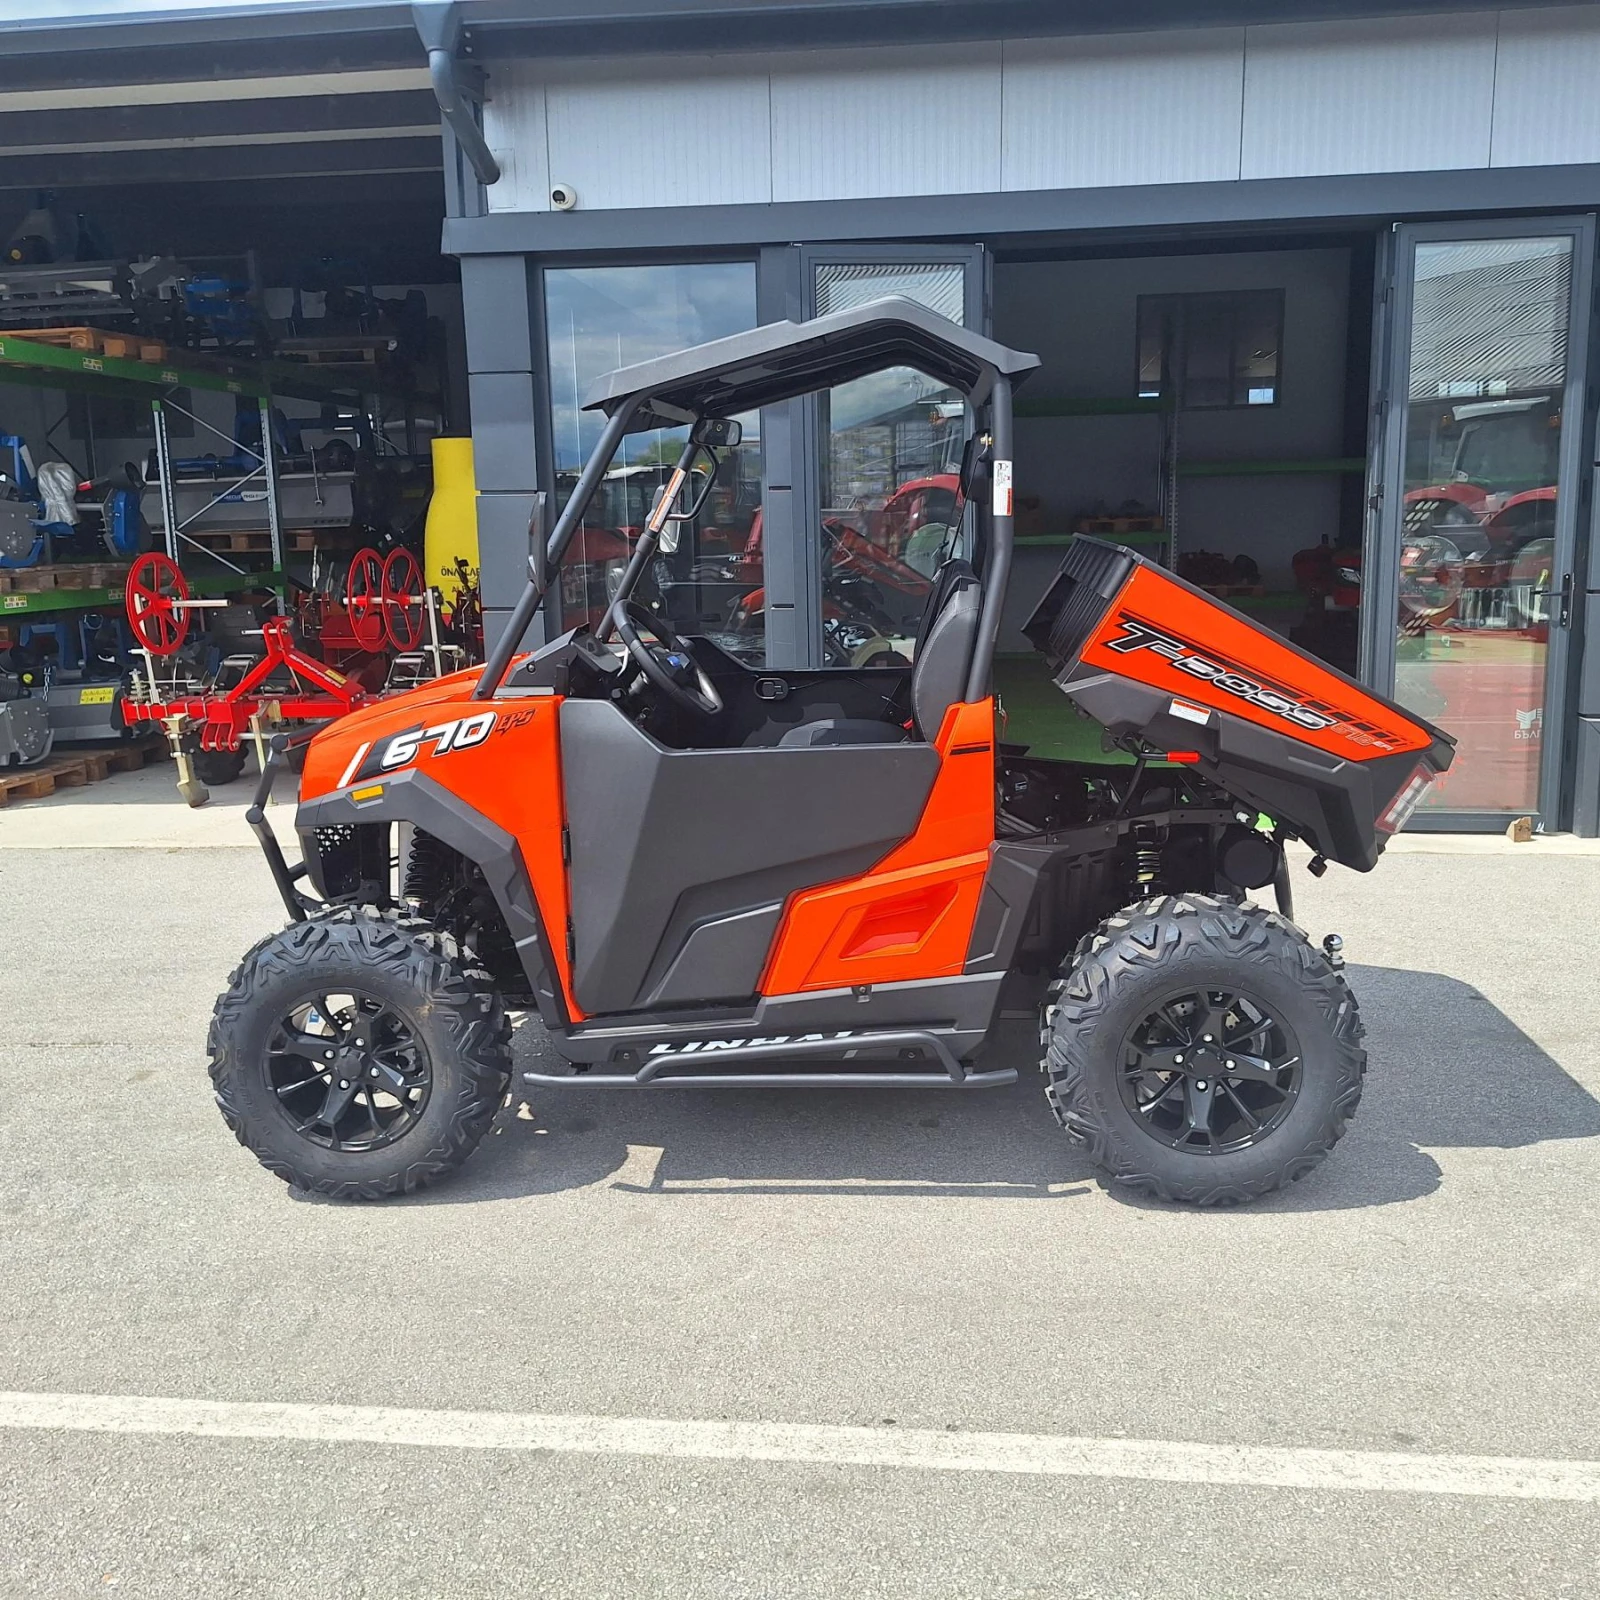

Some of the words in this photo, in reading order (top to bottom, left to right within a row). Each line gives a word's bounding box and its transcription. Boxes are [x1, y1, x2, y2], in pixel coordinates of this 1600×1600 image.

[1107, 620, 1338, 731] T-BOSS
[380, 711, 498, 772] 670
[496, 708, 536, 736] EPS
